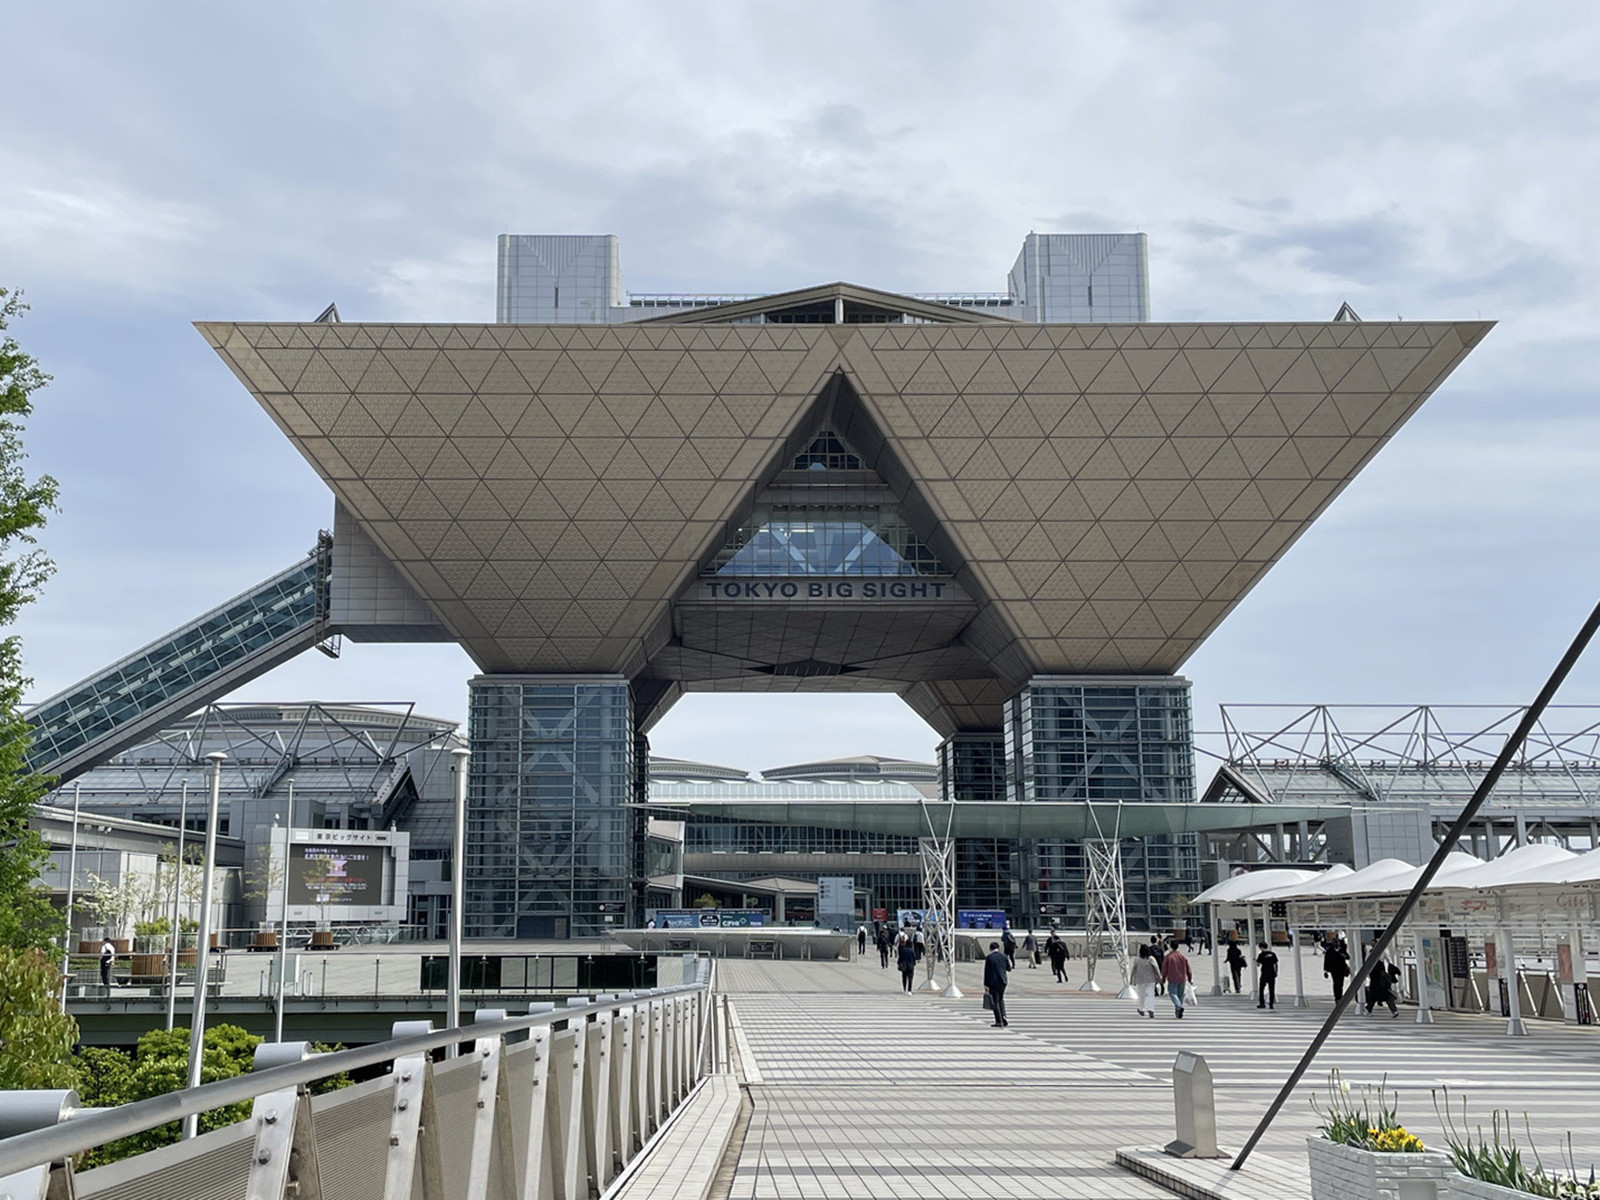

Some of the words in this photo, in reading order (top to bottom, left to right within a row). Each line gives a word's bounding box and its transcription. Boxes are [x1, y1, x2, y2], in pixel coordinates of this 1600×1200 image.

[706, 582, 798, 598] TOKYO
[808, 582, 853, 598] BIG
[862, 582, 946, 598] SIGHT
[317, 833, 371, 841] 東京ビッグサイト
